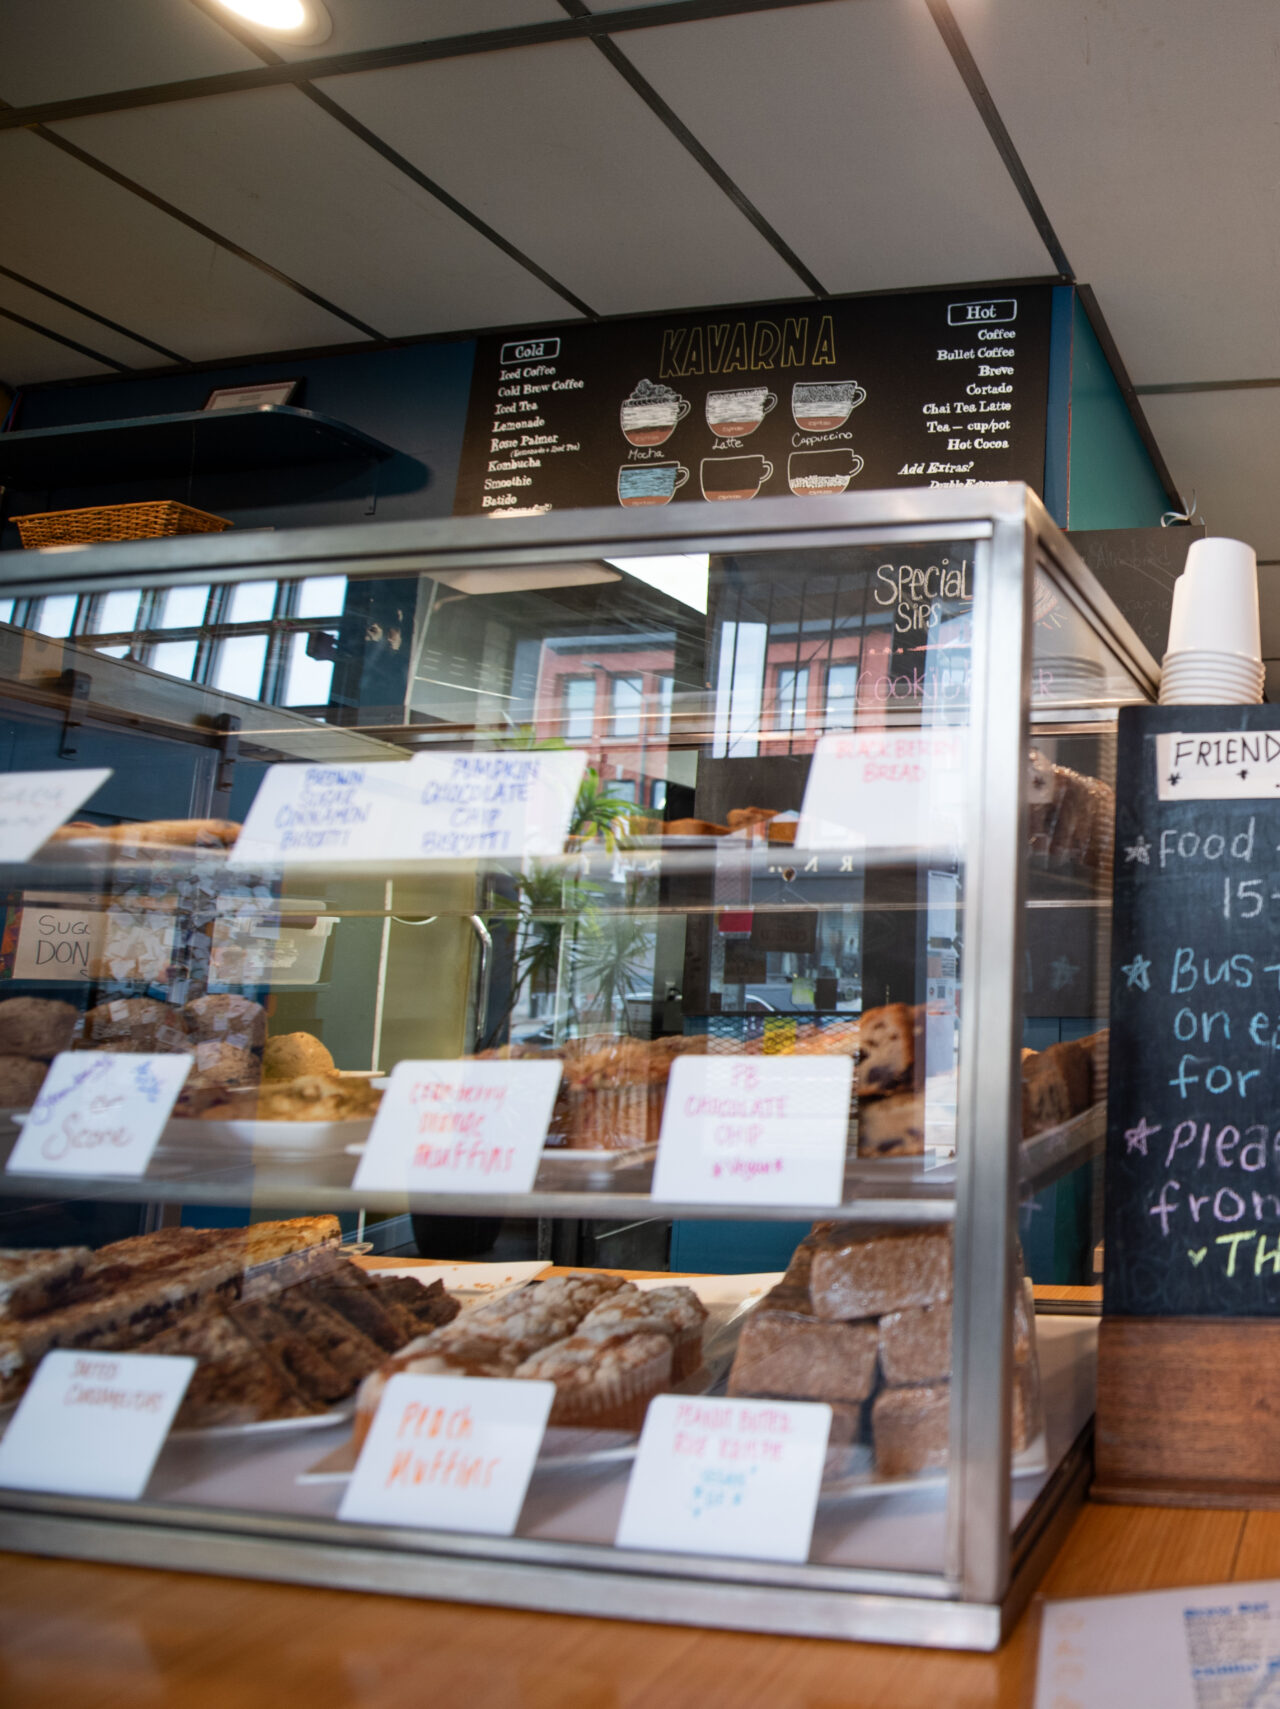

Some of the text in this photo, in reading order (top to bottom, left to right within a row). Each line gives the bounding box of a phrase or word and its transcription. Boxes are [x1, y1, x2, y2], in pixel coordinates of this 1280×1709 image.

[966, 304, 997, 320] Hot
[978, 329, 1016, 340] Coffee
[515, 343, 544, 358] Cold
[659, 315, 836, 379] KAVARNA
[937, 347, 1015, 361] Bullet Coffee
[499, 365, 556, 381] Iced Coffee
[978, 365, 1014, 377] Breve
[498, 378, 584, 397] Cold Brew Coffee
[966, 382, 1013, 395] Cortado
[494, 400, 538, 415] Iced Tea
[922, 400, 1012, 415] Chai Tea Latte
[492, 416, 545, 433] Lemonade
[926, 421, 951, 433] Tea
[967, 418, 1011, 434] cup/pot
[520, 434, 559, 446] Palmer
[712, 438, 744, 450] Latte
[792, 431, 853, 447] Cappuccino
[947, 438, 1009, 450] Hot Cocoa
[628, 449, 665, 460] Mocha
[488, 457, 541, 472] Kombucha
[897, 461, 975, 475] Add Extras?
[484, 475, 533, 491] Smoothie
[482, 493, 518, 508] Batido
[1174, 1007, 1231, 1043] on
[1169, 1054, 1261, 1099] for
